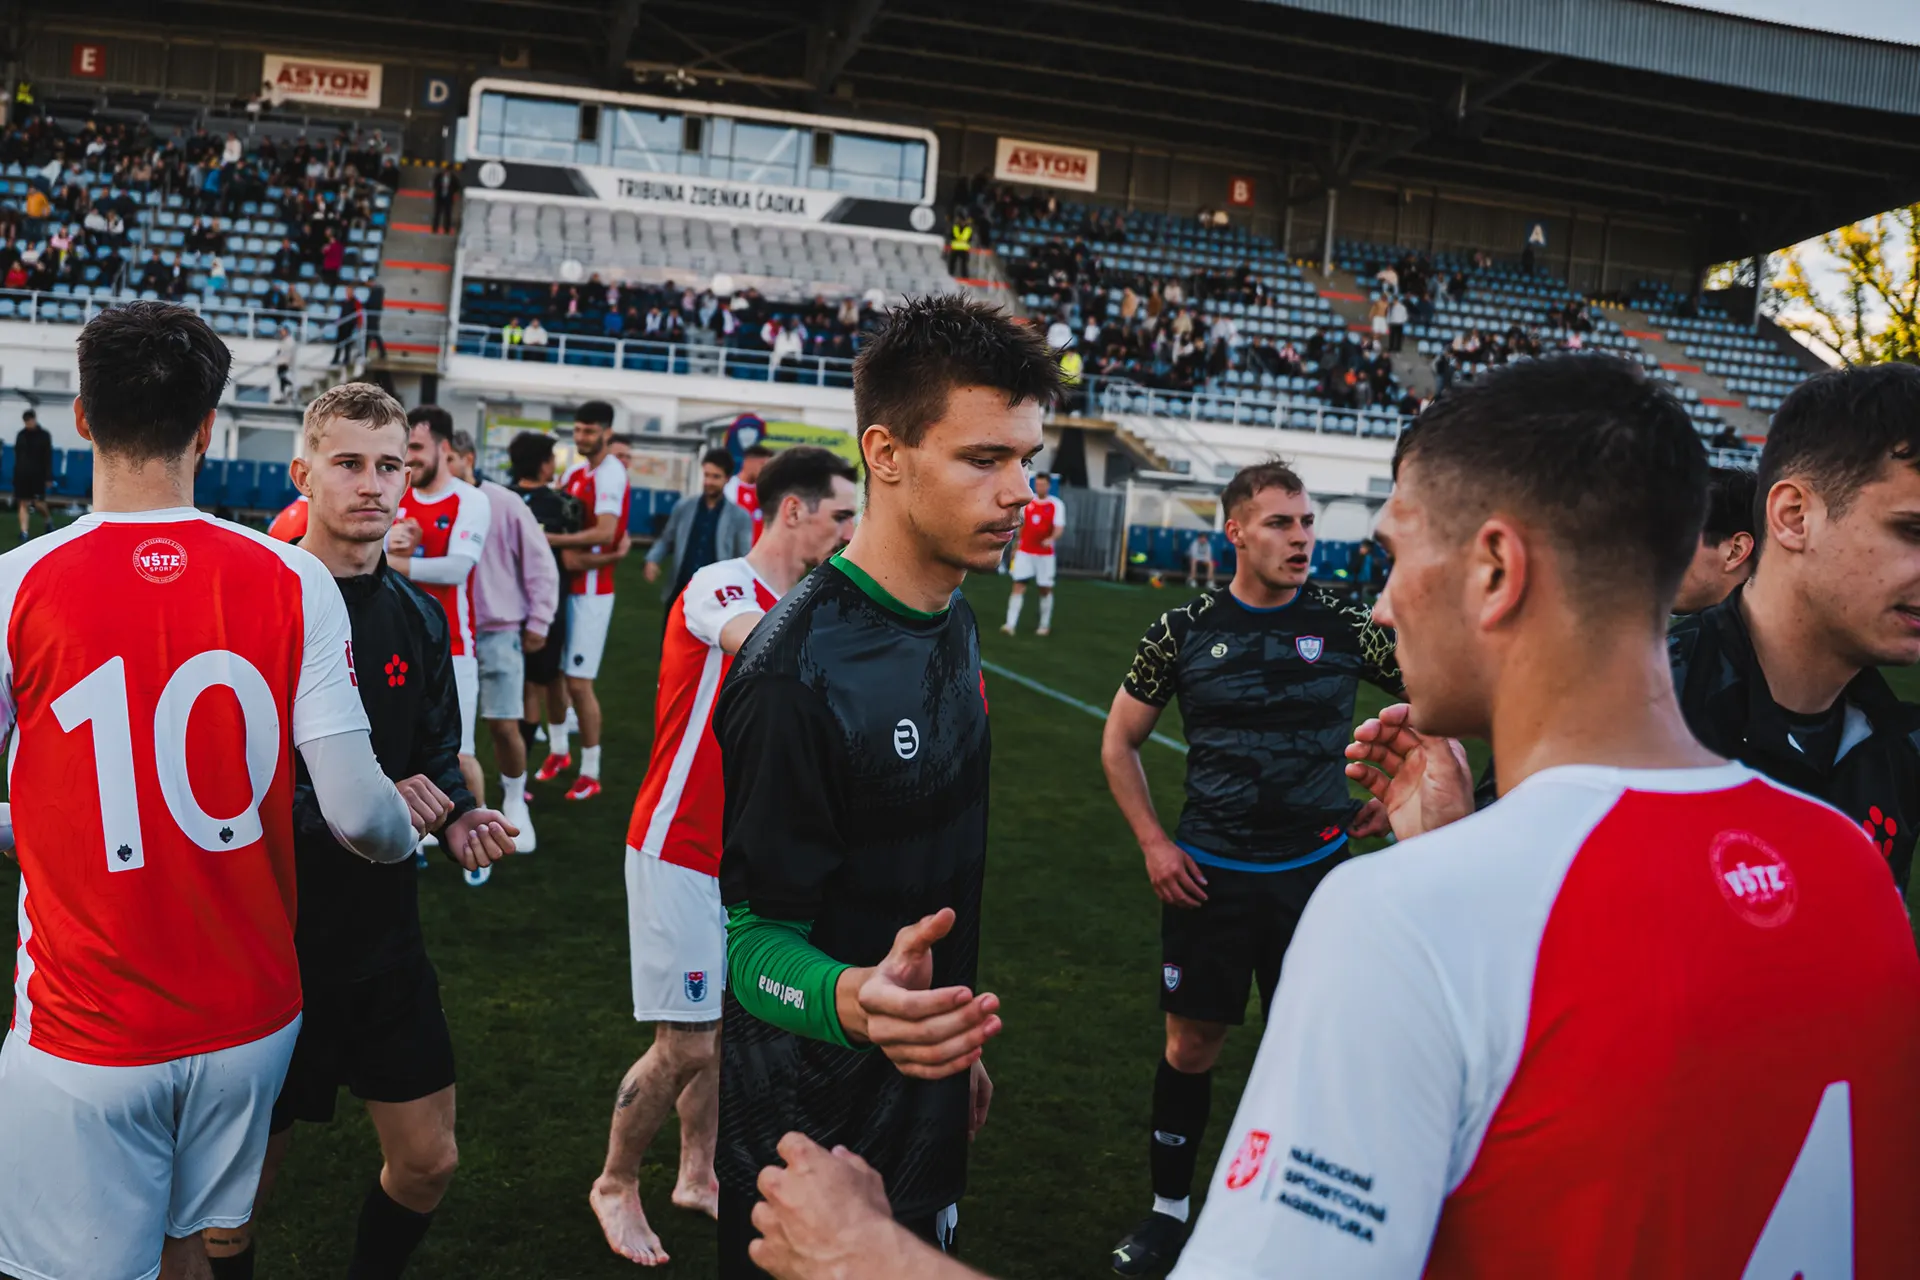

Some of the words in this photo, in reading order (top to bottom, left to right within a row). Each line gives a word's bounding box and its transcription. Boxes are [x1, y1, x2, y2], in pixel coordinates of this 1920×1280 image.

[82, 48, 97, 72] E
[277, 65, 370, 92] ASTON
[429, 80, 449, 104] D
[1008, 150, 1088, 175] ASTON
[618, 178, 685, 203] TRIBUNA
[690, 185, 750, 209] ZDENKA
[1234, 180, 1248, 203] B
[1529, 224, 1545, 245] A
[140, 552, 180, 567] VŠTE
[50, 649, 280, 873] 10
[758, 974, 804, 1010] Beltona
